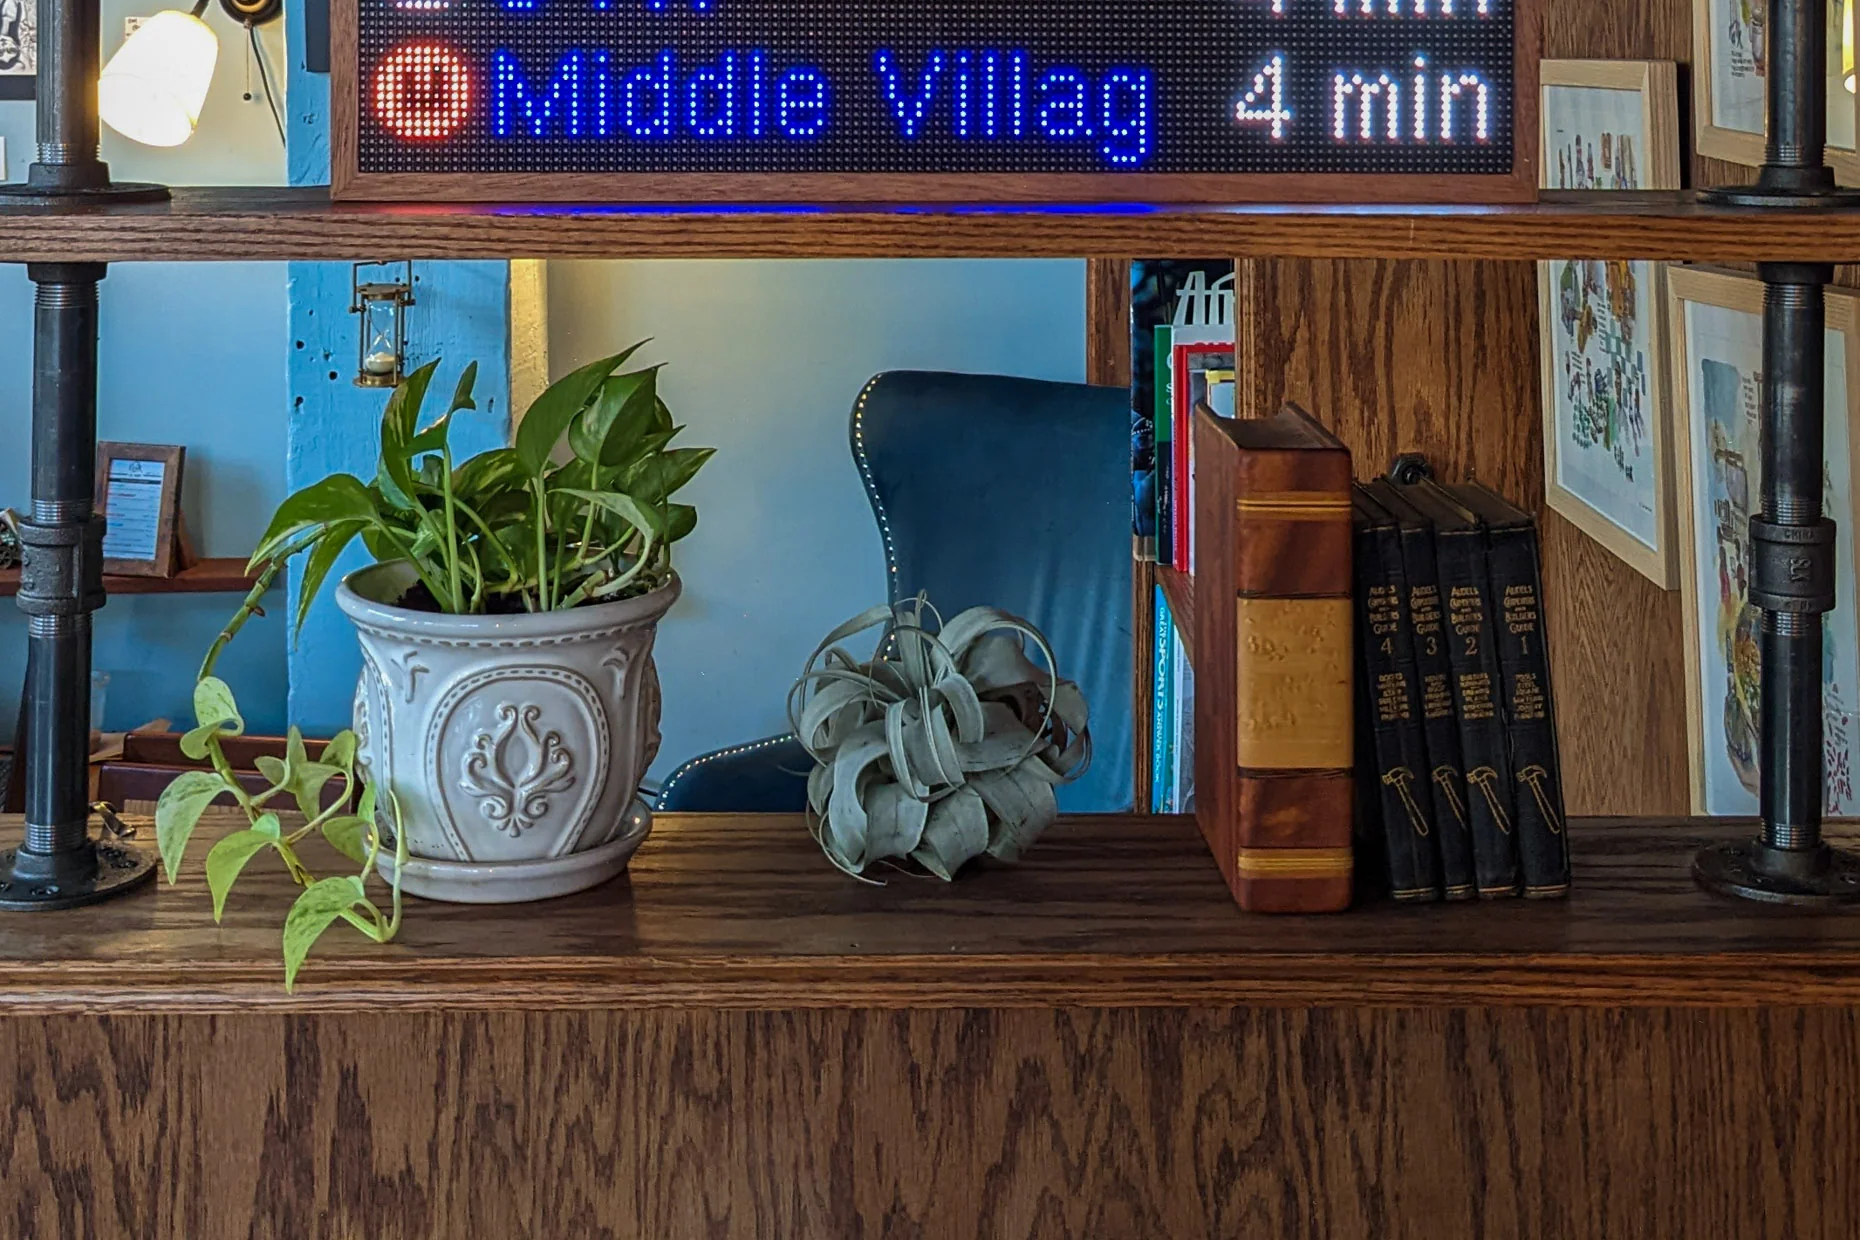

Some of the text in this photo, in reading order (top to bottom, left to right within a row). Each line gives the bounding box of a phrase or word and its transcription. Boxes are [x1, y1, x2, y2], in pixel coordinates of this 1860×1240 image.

[495, 51, 826, 137] Middle
[877, 52, 1149, 165] Villag
[1235, 56, 1290, 139] 4
[1333, 56, 1487, 139] min
[1380, 637, 1393, 655] 4
[1426, 636, 1438, 655] 3
[1464, 636, 1478, 655] 2
[1520, 635, 1529, 655] 1
[1156, 637, 1168, 710] SPORTS
